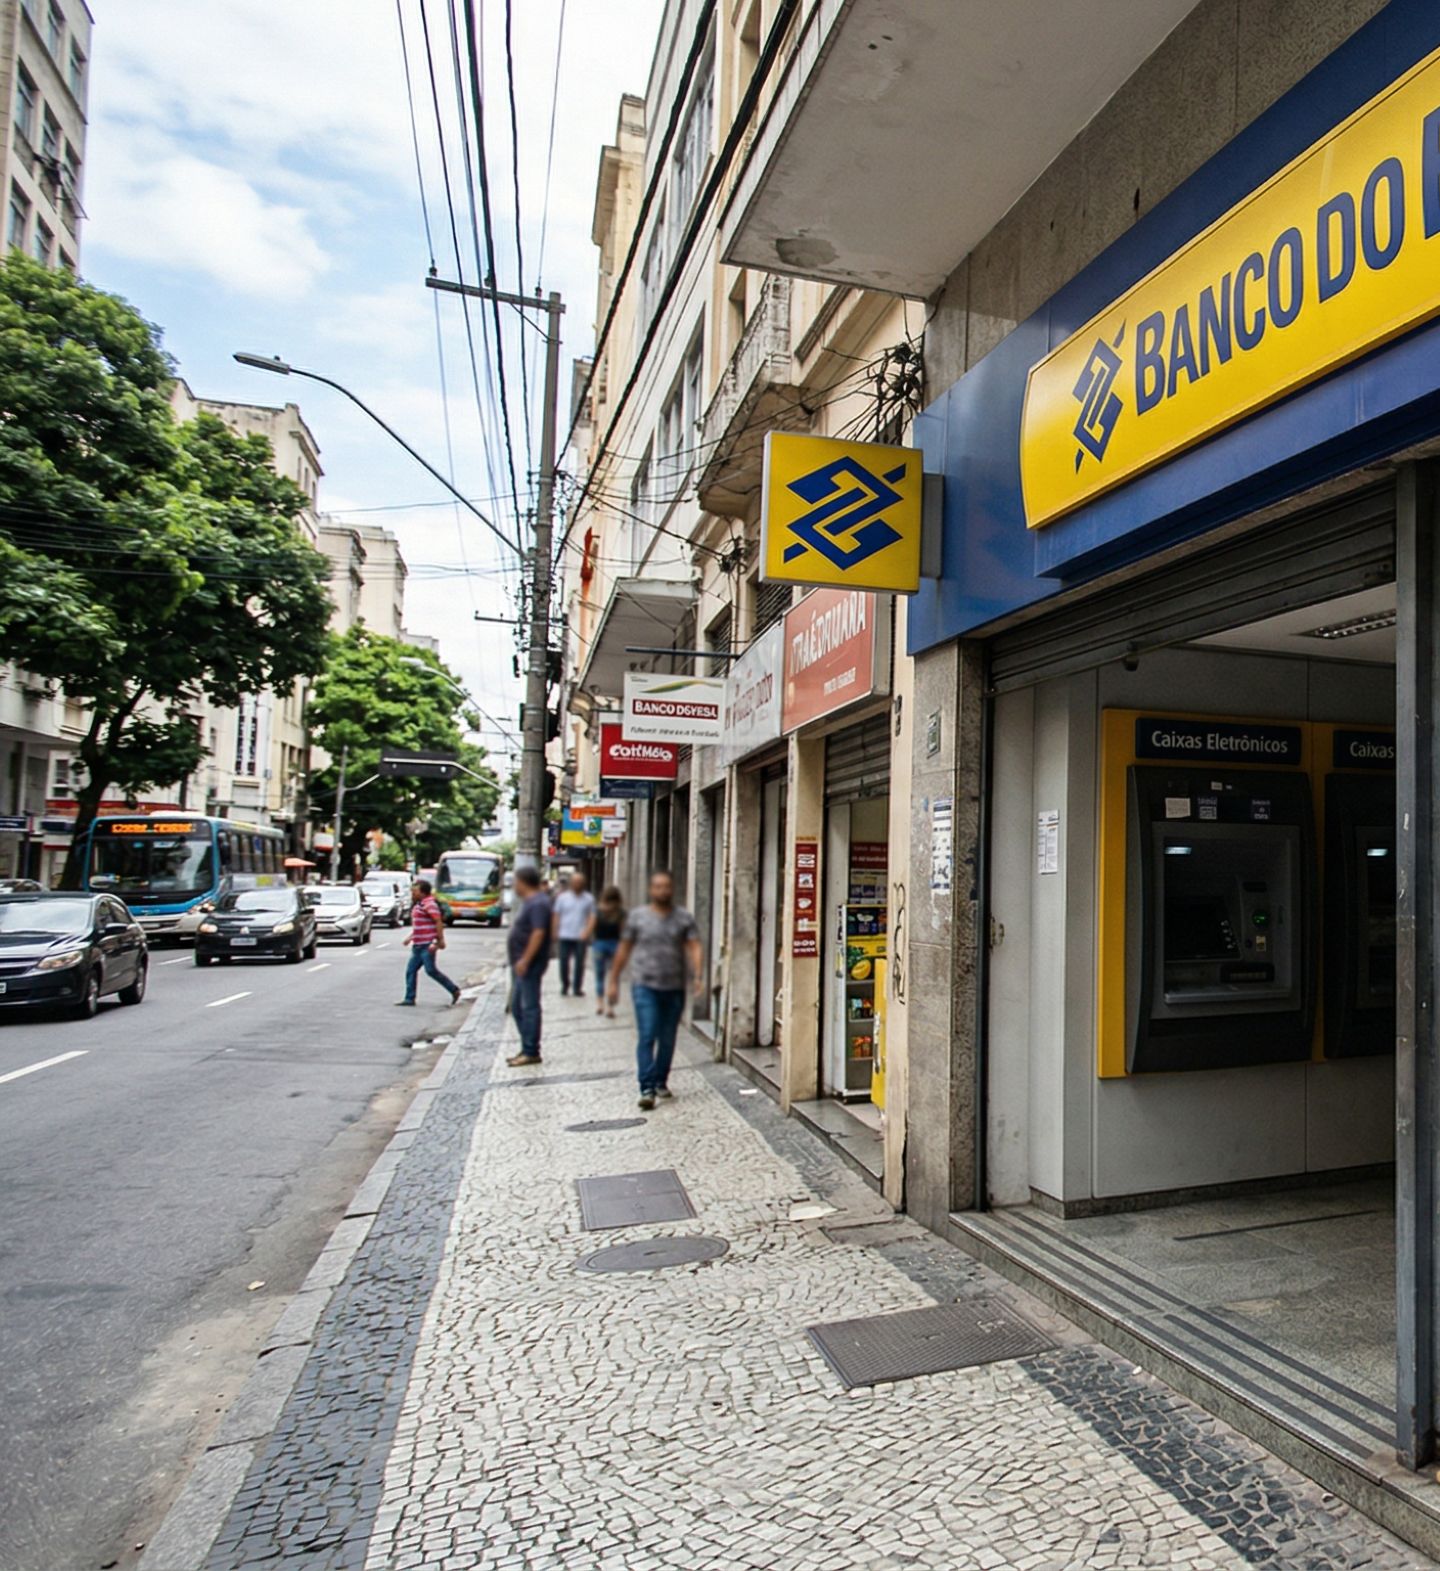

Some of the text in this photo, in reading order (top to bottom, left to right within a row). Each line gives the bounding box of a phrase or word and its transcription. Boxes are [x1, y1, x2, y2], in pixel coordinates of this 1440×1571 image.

[1136, 226, 1304, 416] BANCO
[1318, 157, 1405, 304] DO
[635, 701, 675, 715] BANCO
[1151, 730, 1289, 754] Caixas Eletrônicos
[1350, 741, 1395, 759] Caixas
